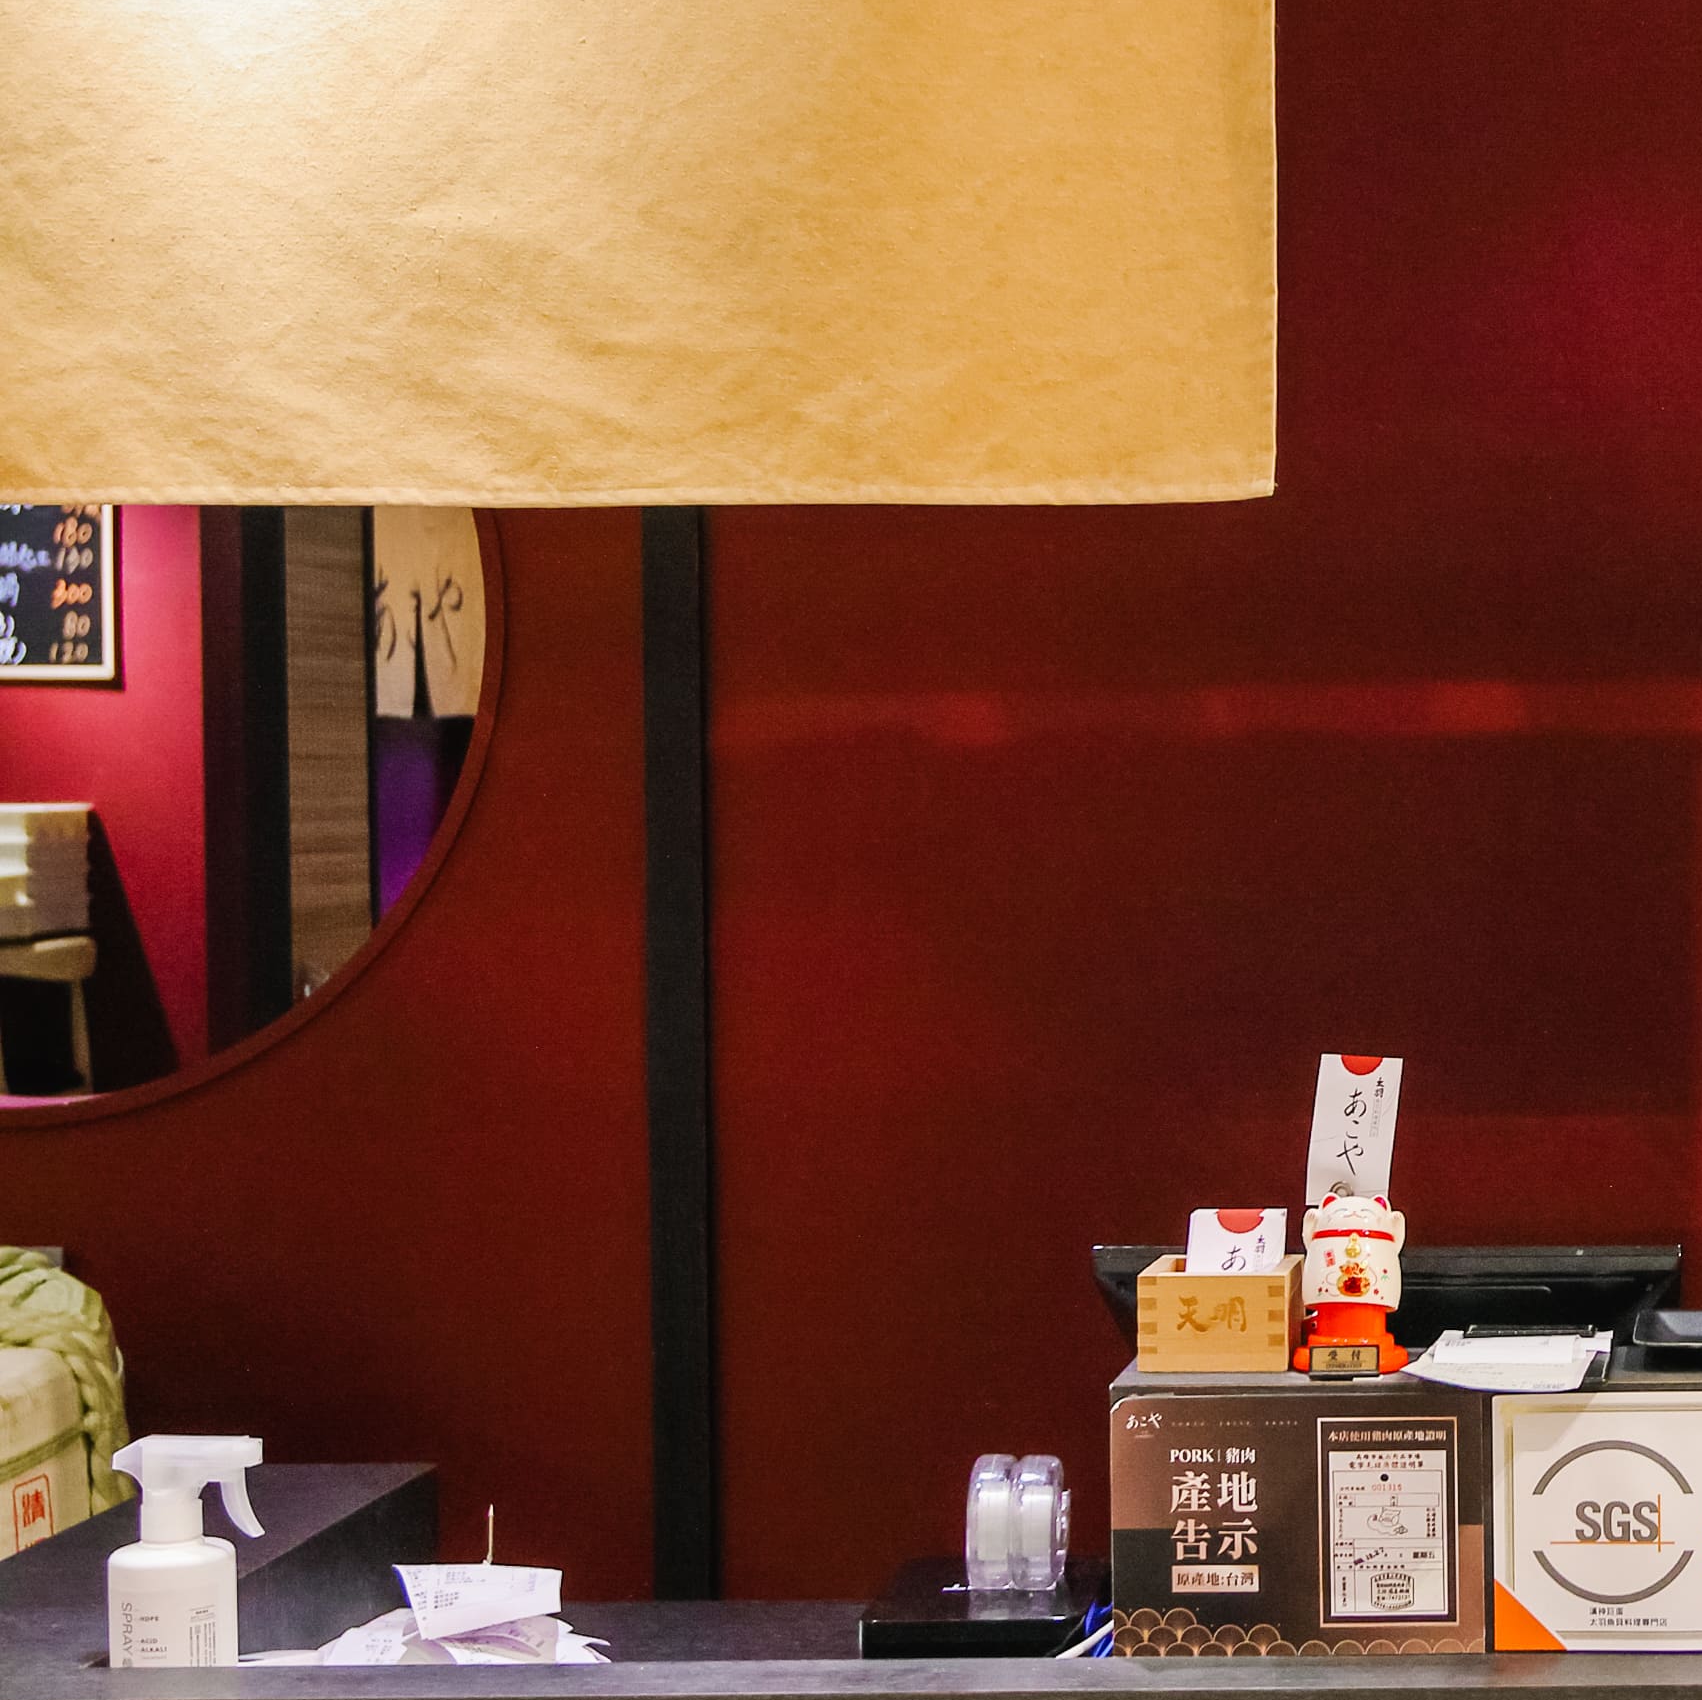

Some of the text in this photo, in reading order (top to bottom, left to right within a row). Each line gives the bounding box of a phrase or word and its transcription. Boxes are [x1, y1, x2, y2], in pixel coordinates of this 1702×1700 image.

[1336, 1087, 1367, 1177] あこや
[1125, 1413, 1162, 1430] あこや
[1169, 1447, 1256, 1464] PORK 豬肉
[1169, 1471, 1258, 1514] 產地
[1171, 1518, 1258, 1561] 告示
[1575, 1500, 1660, 1544] SGS
[121, 1602, 133, 1656] SPRAY
